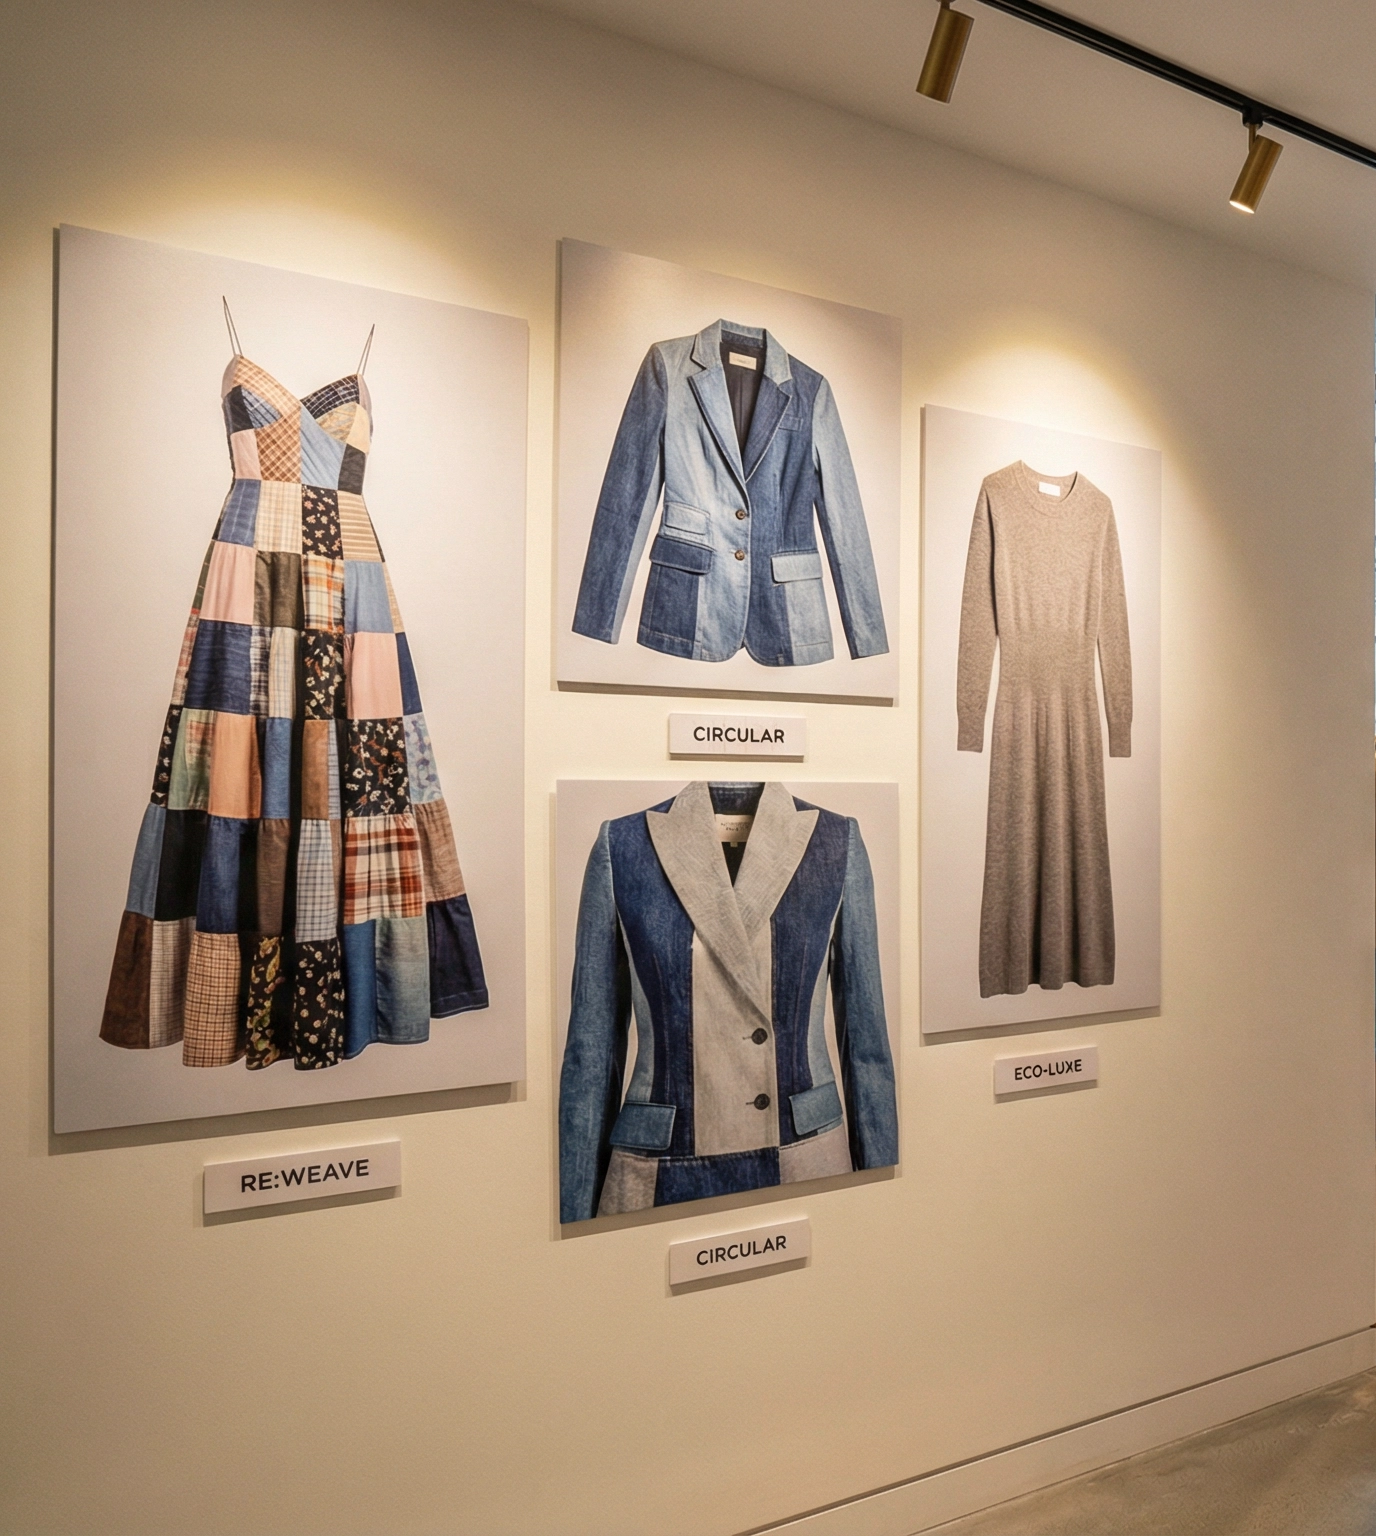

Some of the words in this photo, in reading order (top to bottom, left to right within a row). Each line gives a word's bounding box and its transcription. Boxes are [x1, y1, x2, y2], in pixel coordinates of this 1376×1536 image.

[693, 726, 785, 743] CIRCULAR
[1014, 1059, 1082, 1080] ECO-LUXE
[241, 1159, 370, 1193] RE:WEAVE
[696, 1235, 787, 1265] CIRCULAR
